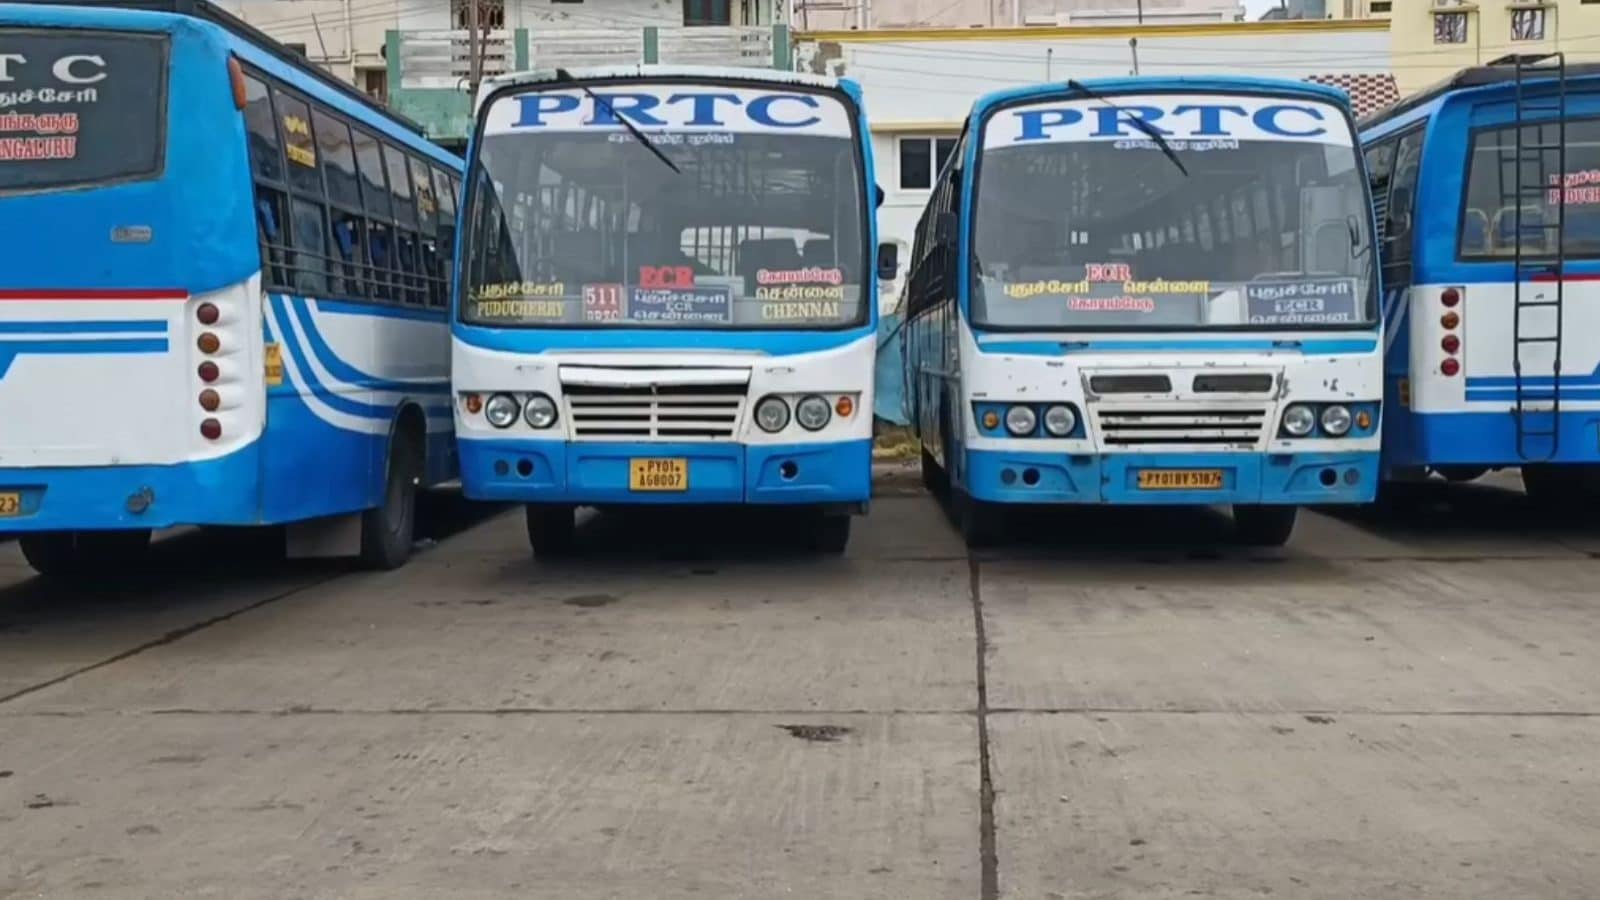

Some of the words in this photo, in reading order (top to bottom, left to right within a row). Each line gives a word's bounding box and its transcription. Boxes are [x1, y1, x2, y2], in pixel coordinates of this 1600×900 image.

[511, 93, 821, 128] PRTC
[1013, 105, 1327, 141] PRTC
[0, 136, 77, 160] NGALURU
[640, 266, 694, 288] ECR
[1085, 263, 1131, 281] ECR
[586, 288, 617, 305] 511
[1004, 280, 1089, 297] புதுச்சேரி
[1123, 278, 1210, 294] சென்னை
[478, 301, 564, 316] PUDUCHERRY
[762, 302, 838, 319] CHENNAI
[647, 460, 674, 472] PY01
